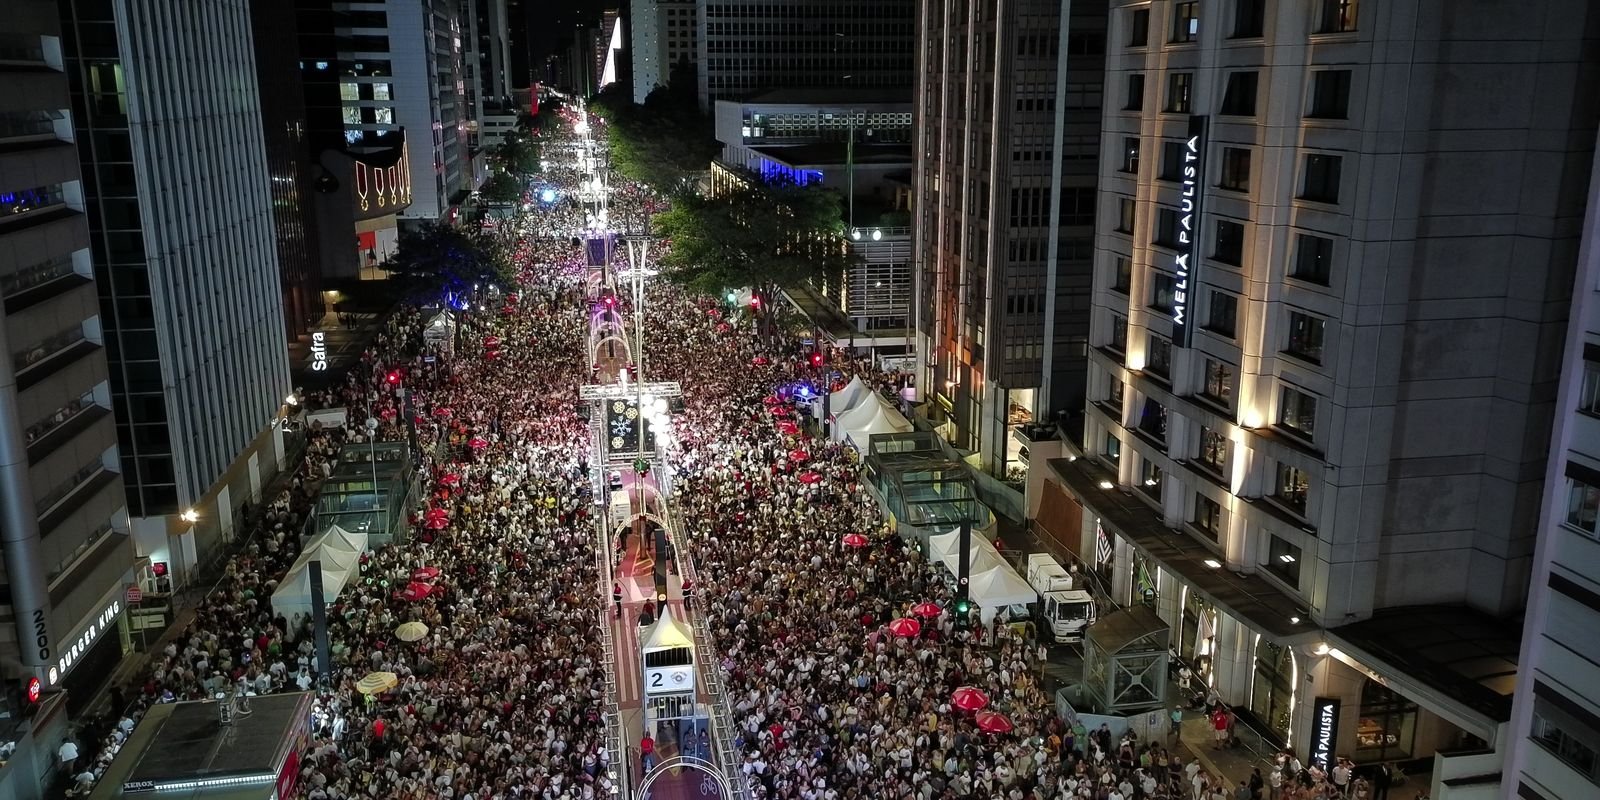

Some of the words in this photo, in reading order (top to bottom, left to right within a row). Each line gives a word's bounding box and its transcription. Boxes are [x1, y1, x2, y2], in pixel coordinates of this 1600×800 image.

[1179, 135, 1198, 244] PAULISTA
[311, 332, 327, 371] Safra
[33, 609, 50, 660] 2200
[60, 625, 96, 674] BURGER
[99, 601, 119, 630] KING
[651, 672, 664, 687] 2
[1318, 704, 1334, 751] PAULISTA
[124, 780, 154, 789] XEROX
